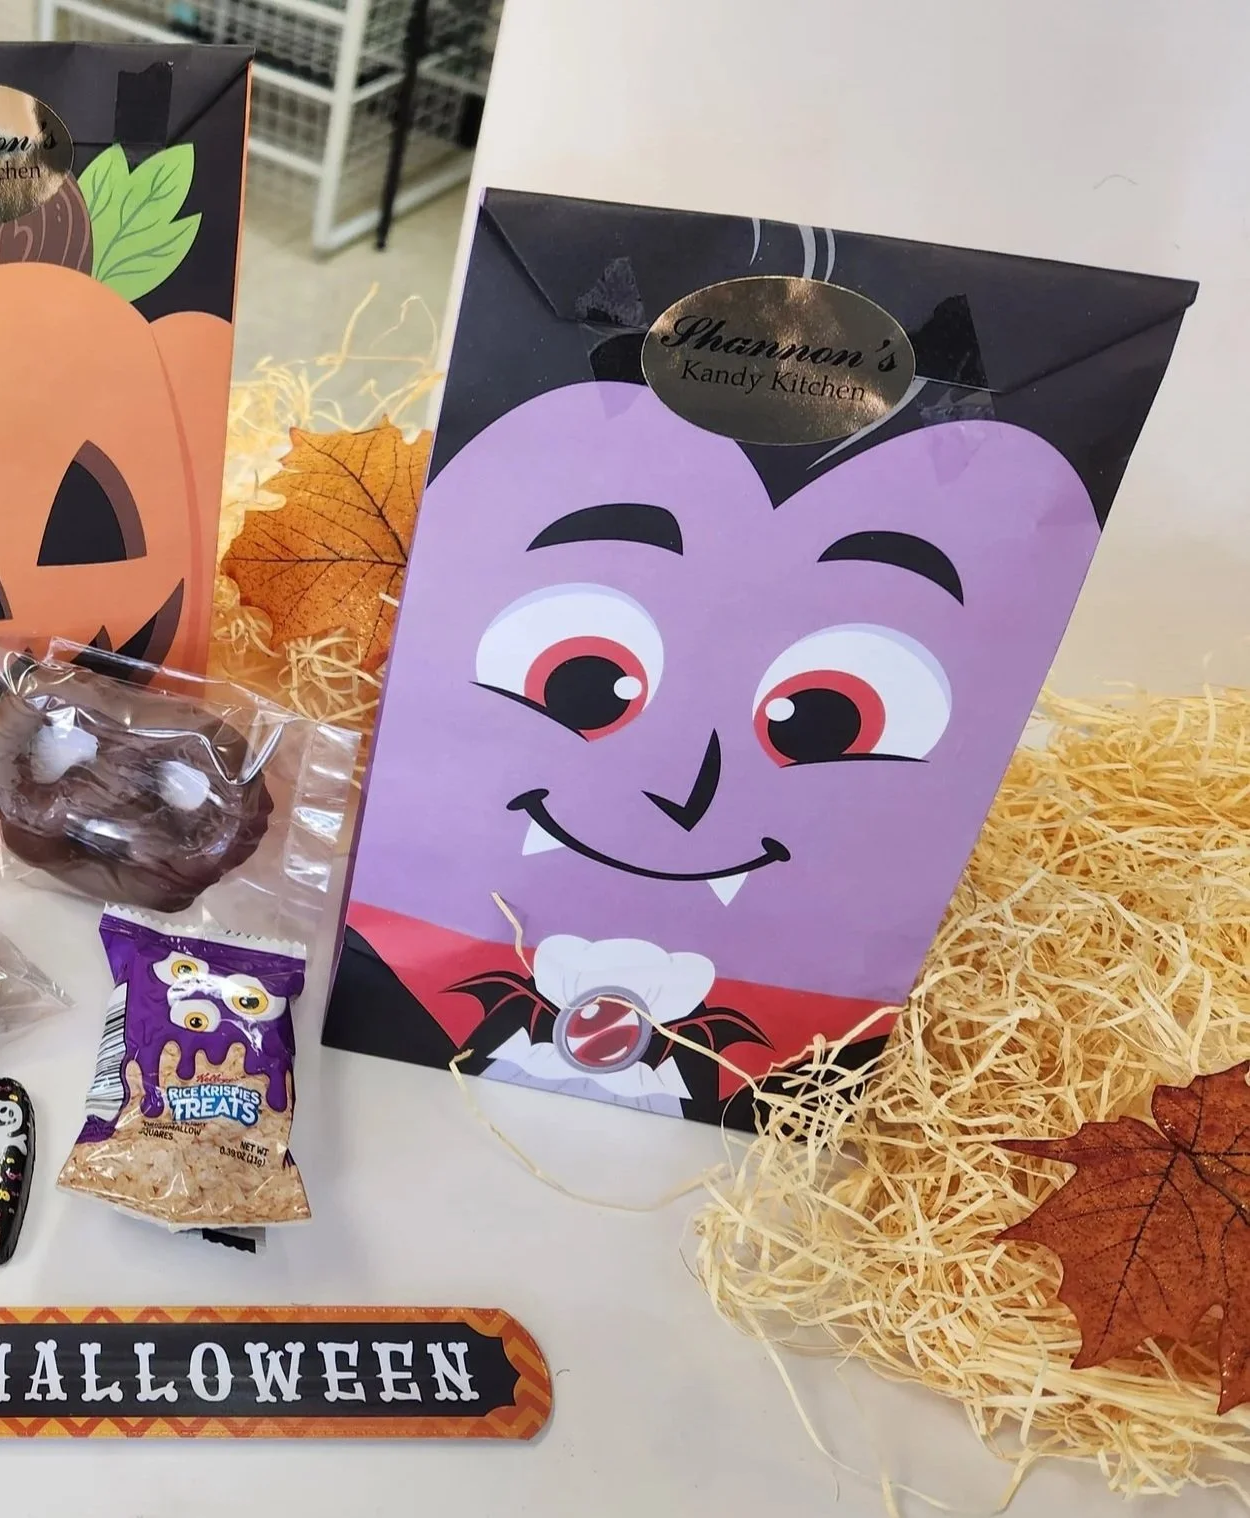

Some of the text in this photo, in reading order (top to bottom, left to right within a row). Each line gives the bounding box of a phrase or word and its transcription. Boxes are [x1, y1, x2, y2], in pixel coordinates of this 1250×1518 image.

[659, 314, 899, 373] Shannon's
[680, 359, 866, 402] Kandy Kitchen
[168, 1084, 260, 1105] RICE KRISPIES
[171, 1097, 257, 1125] TREATS
[240, 1140, 270, 1157] NET WT
